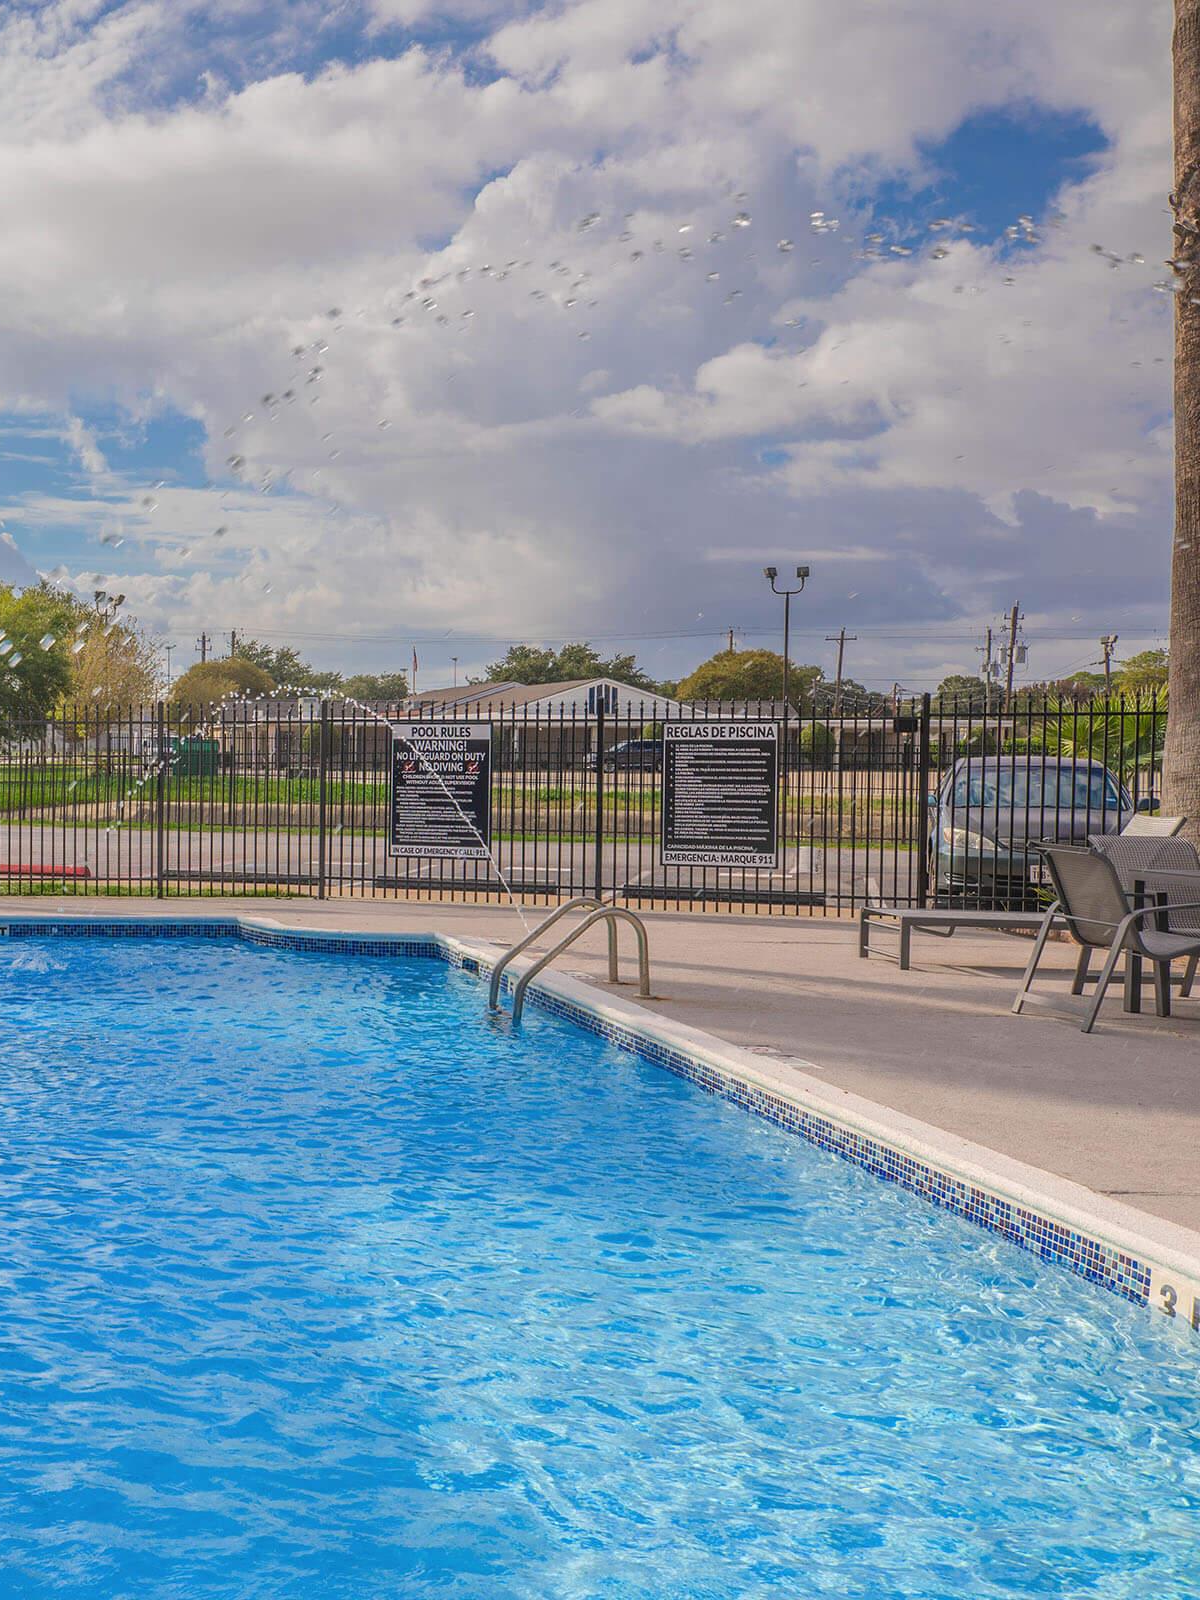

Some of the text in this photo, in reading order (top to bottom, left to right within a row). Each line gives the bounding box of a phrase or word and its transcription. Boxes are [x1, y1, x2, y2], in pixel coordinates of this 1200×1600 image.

[412, 727, 471, 738] POOL RULES
[667, 727, 774, 738] REGLAS DE PISCINA
[415, 740, 467, 751] WARNING!
[397, 752, 408, 760] NO
[451, 752, 463, 760] ON
[465, 752, 485, 760] DUTY
[419, 762, 463, 772] NO DIVING
[665, 853, 772, 864] EMERGENCIA: MARQUE 911
[1160, 1284, 1177, 1318] 3
